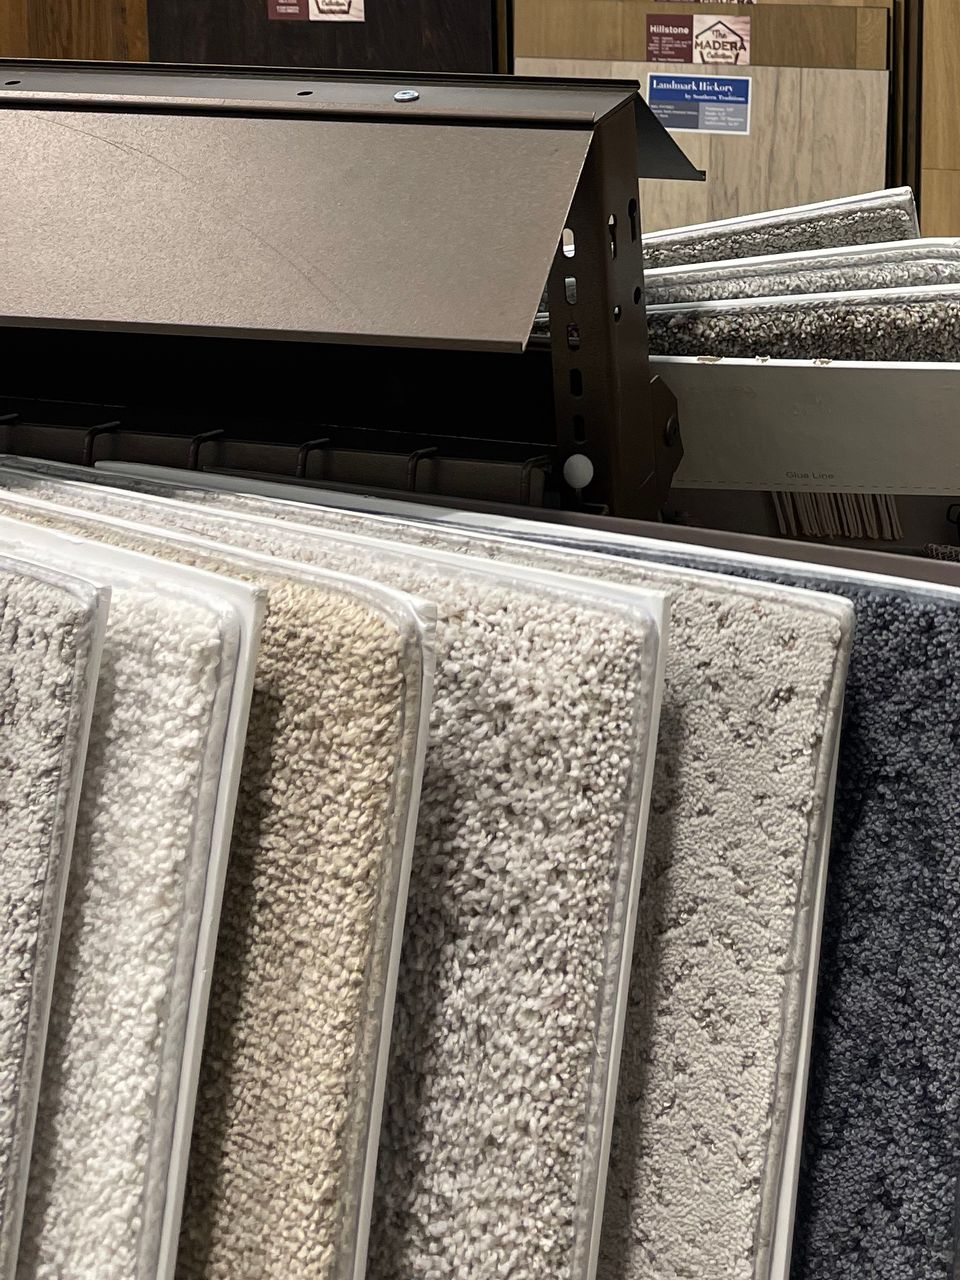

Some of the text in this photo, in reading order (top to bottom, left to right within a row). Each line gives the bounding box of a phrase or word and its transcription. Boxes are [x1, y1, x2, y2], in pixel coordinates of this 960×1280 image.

[650, 25, 690, 35] Hillstone
[712, 29, 727, 39] The
[694, 40, 747, 52] MADERA
[653, 80, 733, 95] Landmark Hickory
[786, 471, 834, 480] Glue Line
